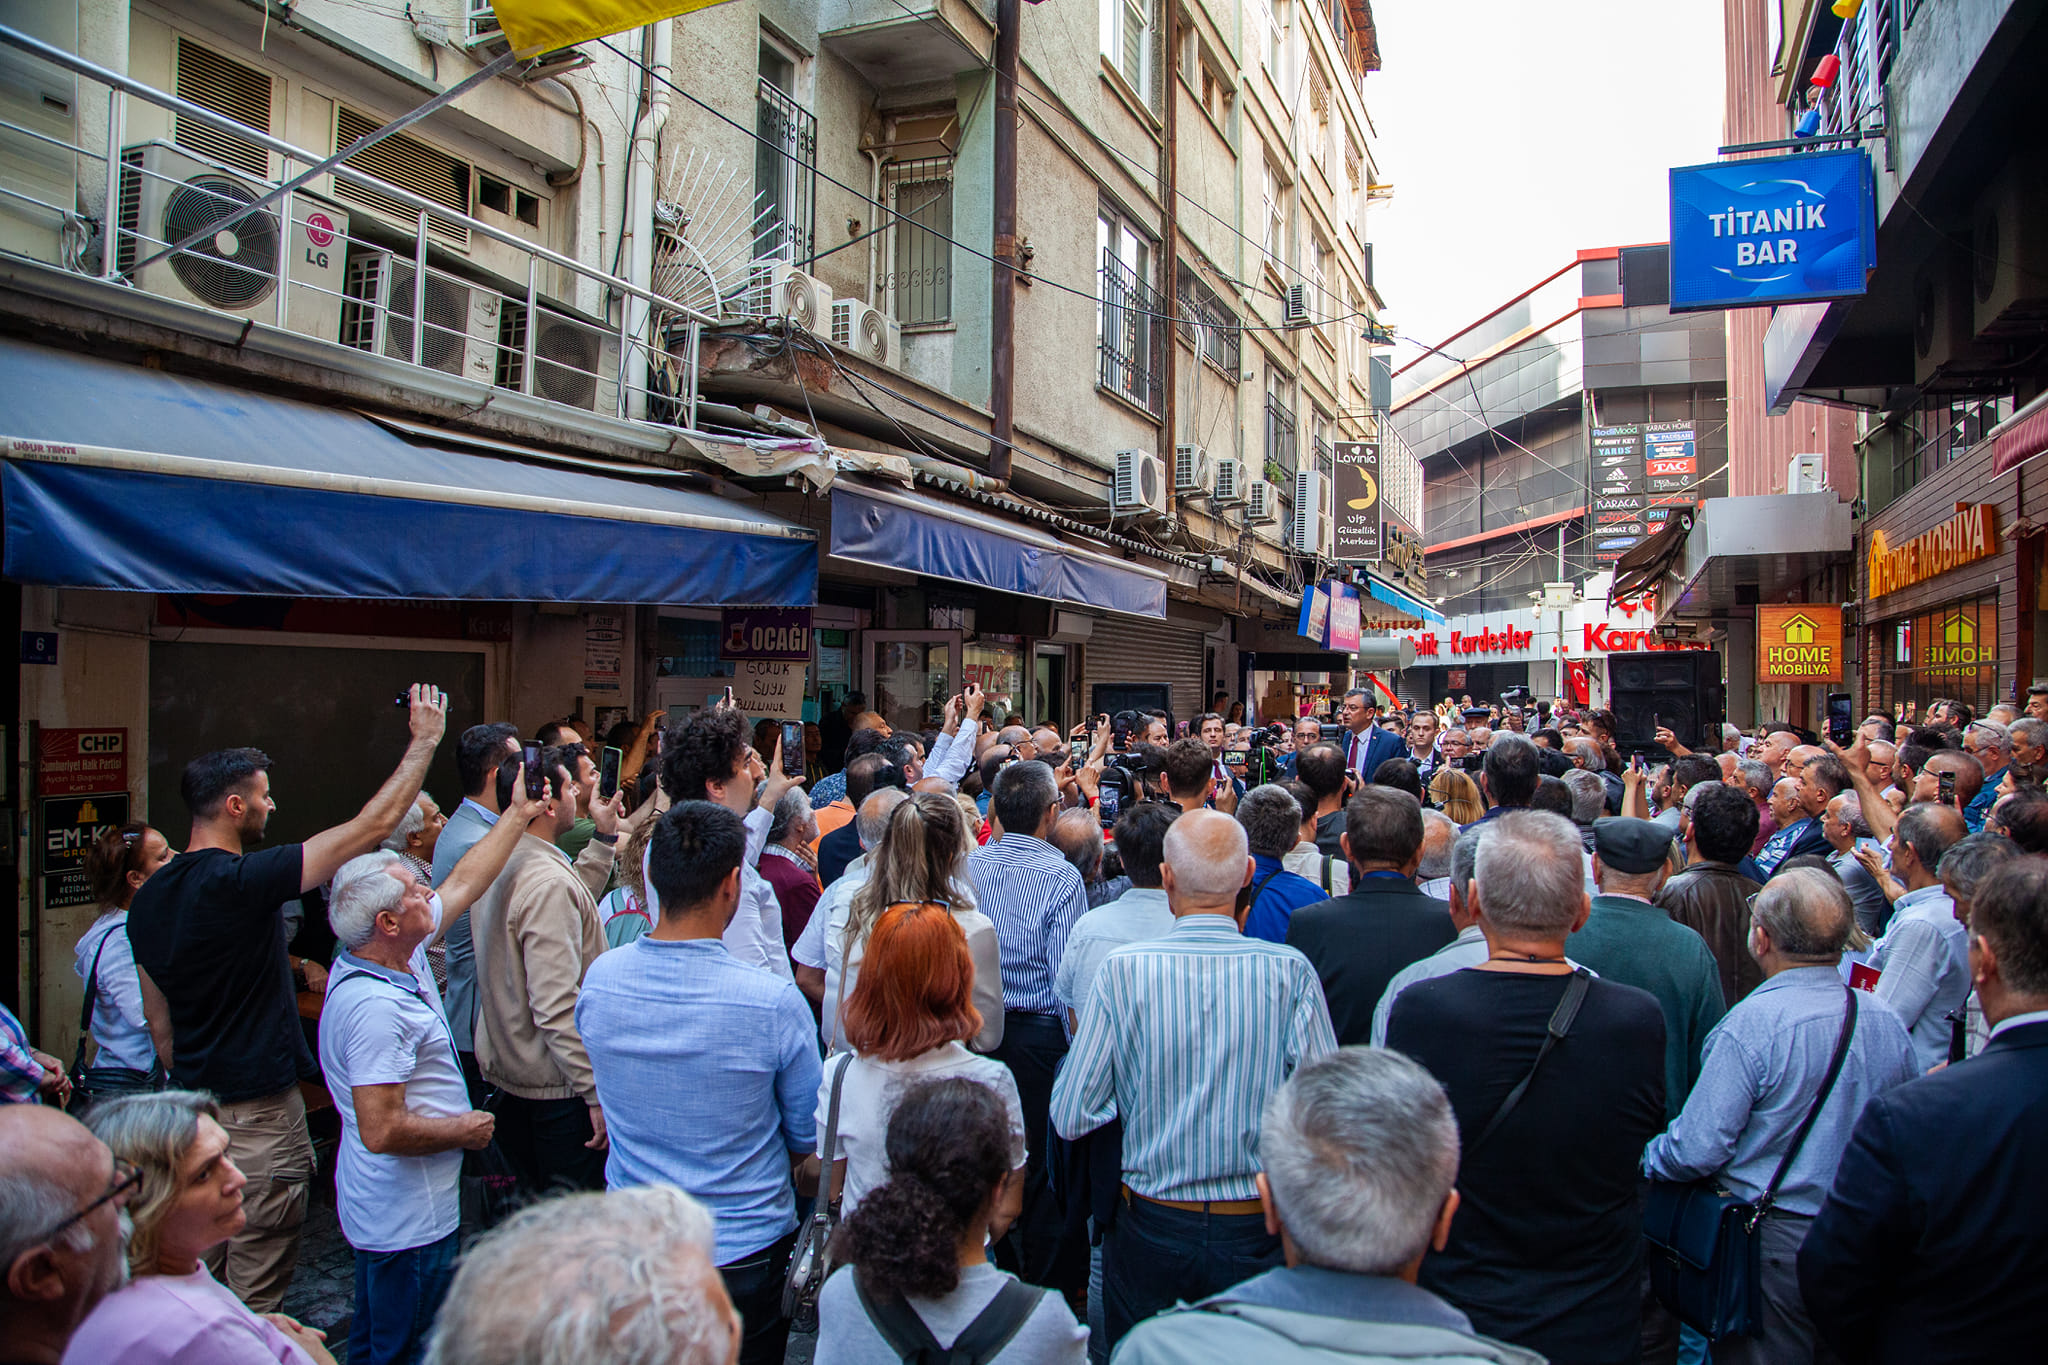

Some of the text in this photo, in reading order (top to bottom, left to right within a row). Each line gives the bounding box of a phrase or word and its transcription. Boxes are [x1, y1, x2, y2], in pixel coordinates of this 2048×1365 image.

[1709, 199, 1826, 238] TİTANİK
[306, 247, 328, 269] LG
[1737, 238, 1798, 267] BAR
[1336, 450, 1377, 464] Lavinia
[1597, 499, 1639, 510] KARACA
[1337, 526, 1377, 535] Güzellik
[1881, 502, 1988, 596] HOME MOBİLYA
[36, 637, 45, 652] 6
[752, 622, 808, 652] OCAĞI
[1451, 624, 1533, 654] Kardeşler
[1769, 647, 1831, 663] HOME
[1770, 661, 1830, 676] MOBİLYA
[81, 736, 120, 751] CHP
